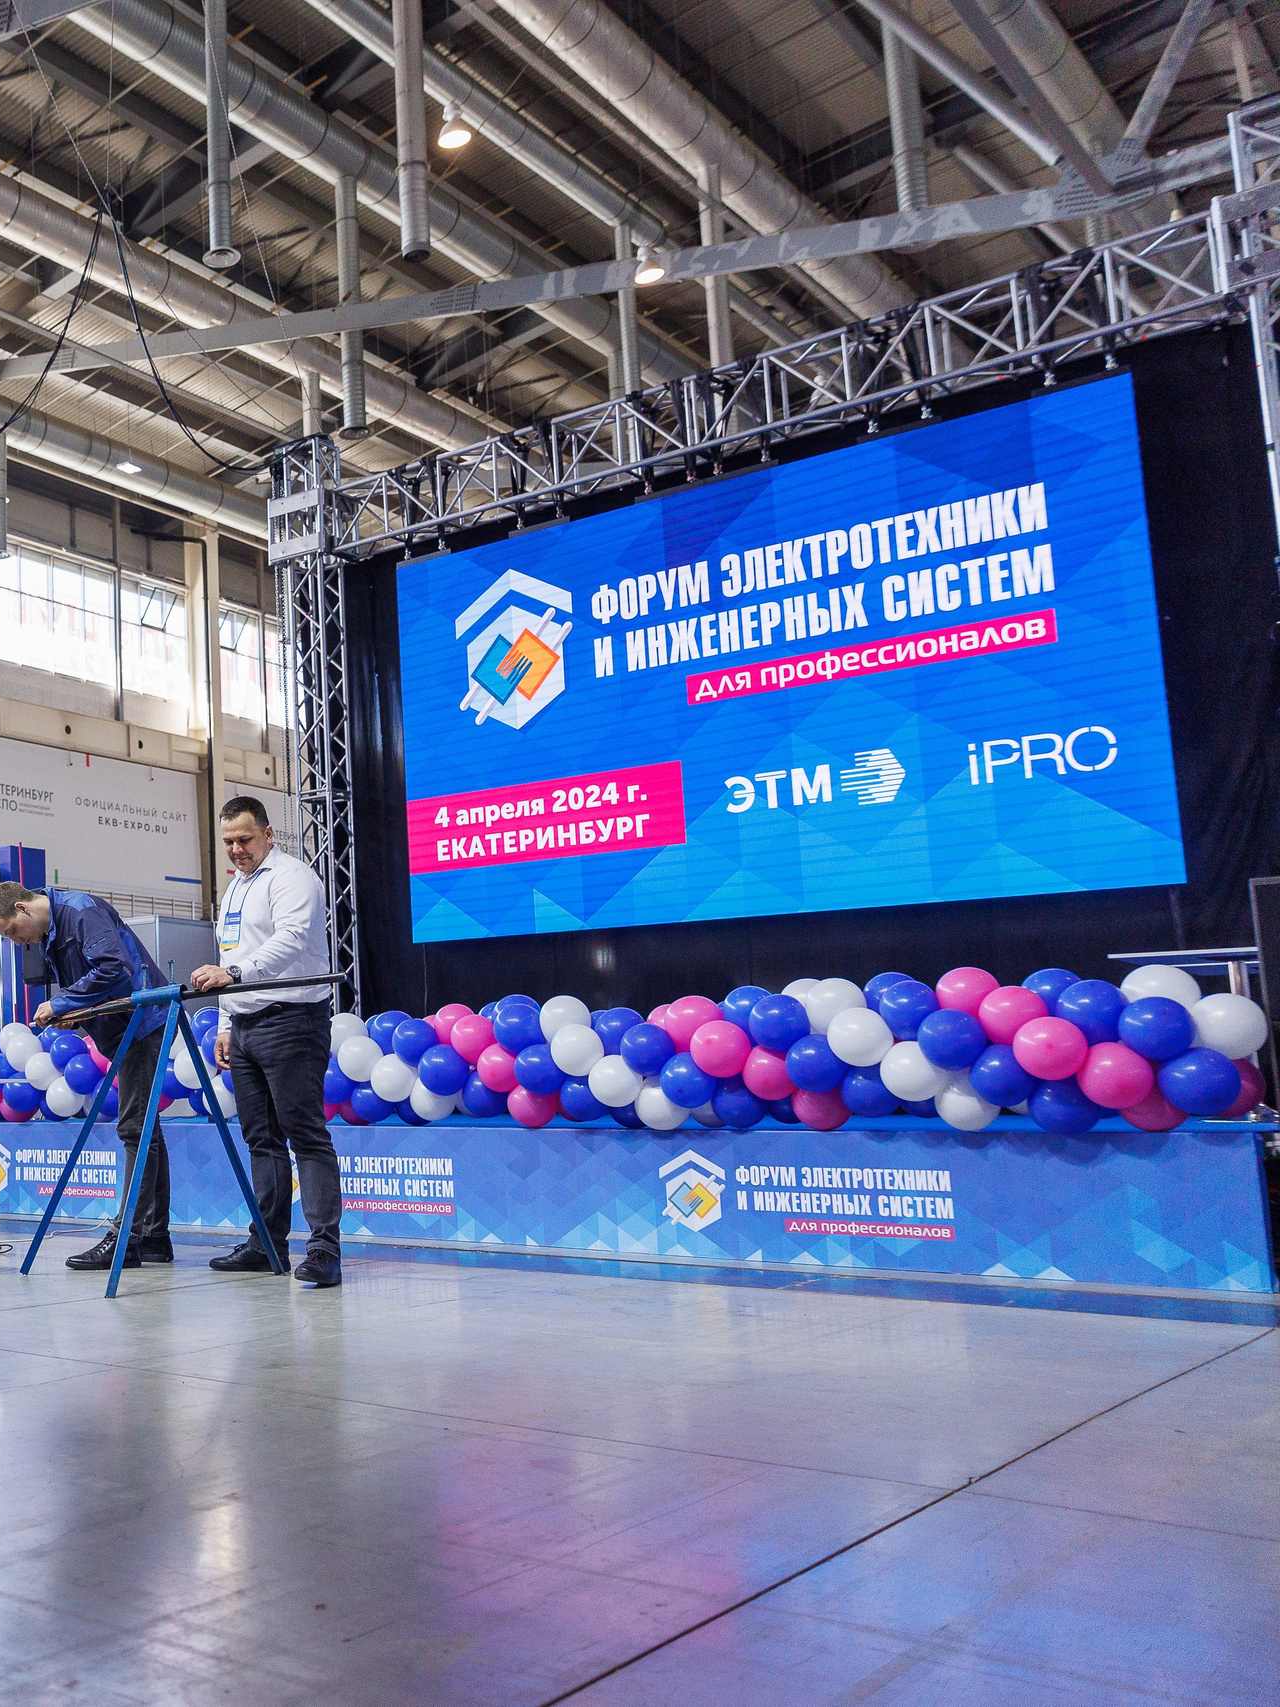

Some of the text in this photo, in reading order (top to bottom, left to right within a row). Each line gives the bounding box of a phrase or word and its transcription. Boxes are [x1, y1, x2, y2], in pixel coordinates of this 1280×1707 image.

[591, 481, 1049, 625] ФОРУМ ЭЛЕКТРОТЕХНИКИ
[593, 543, 1056, 679] И ИНЖЕНЕРНЫХ СИСТЕМ
[694, 618, 1047, 702] для профессионалов
[968, 725, 1118, 785] iPRO
[724, 763, 833, 814] ЭТМ
[75, 796, 158, 818] ОФИЦИАЛЬНЫЙ
[162, 810, 187, 823] САЙТ
[434, 781, 648, 828] 4 апреля 2024 г.
[98, 816, 168, 834] EKB-EXPO.RU
[436, 813, 650, 862] ЕКАТЕРИНБУРГ
[15, 1149, 117, 1166] ФОРУМ ЭЛЕКТОТЕХНИКИ
[354, 1156, 453, 1176] ЭЛЕКТРОТЕХНИКИ
[15, 1166, 21, 1181] И
[81, 1168, 117, 1185] СИСТЕМ
[340, 1176, 455, 1198] ЖЕНЕРНЫХ СИСТЕМ
[735, 1165, 952, 1192] ФОРУМ ЭЛЕКТРОТЕХНИКИ
[38, 1187, 53, 1195] для
[345, 1201, 452, 1213] для профессионалов
[737, 1190, 955, 1220] И ИНЖЕНЕРНЫХ СИСТЕМ
[789, 1221, 951, 1238] для профессионалов
